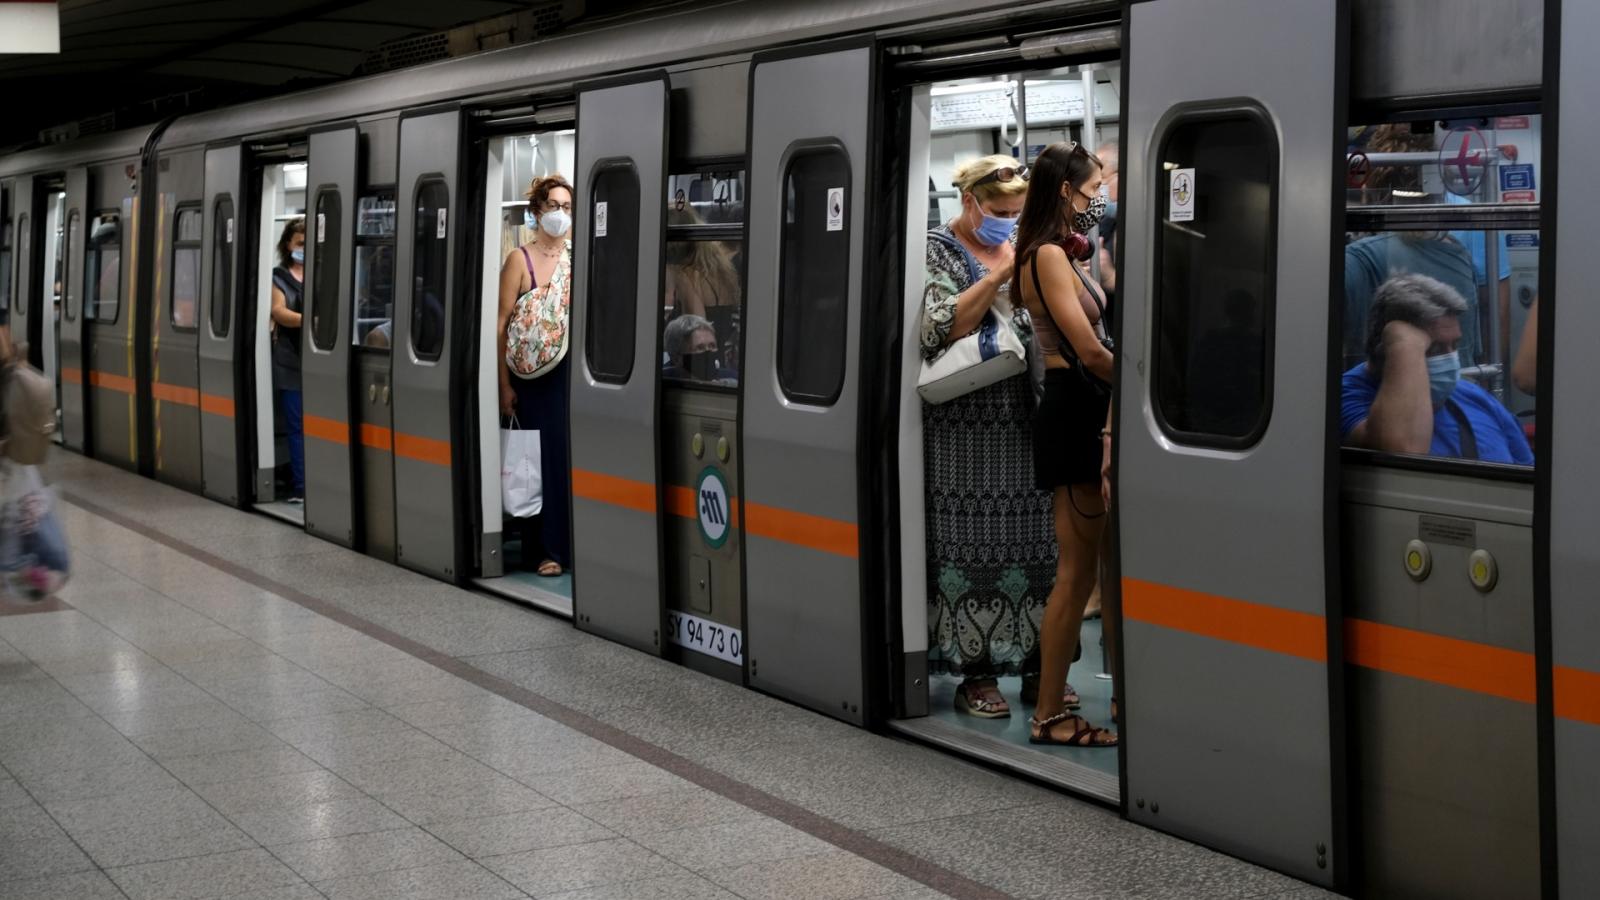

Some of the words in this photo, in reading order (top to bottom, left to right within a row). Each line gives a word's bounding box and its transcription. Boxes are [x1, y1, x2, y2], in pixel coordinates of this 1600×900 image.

[687, 619, 704, 646] 94
[709, 625, 725, 653] 73
[730, 632, 743, 658] 0
